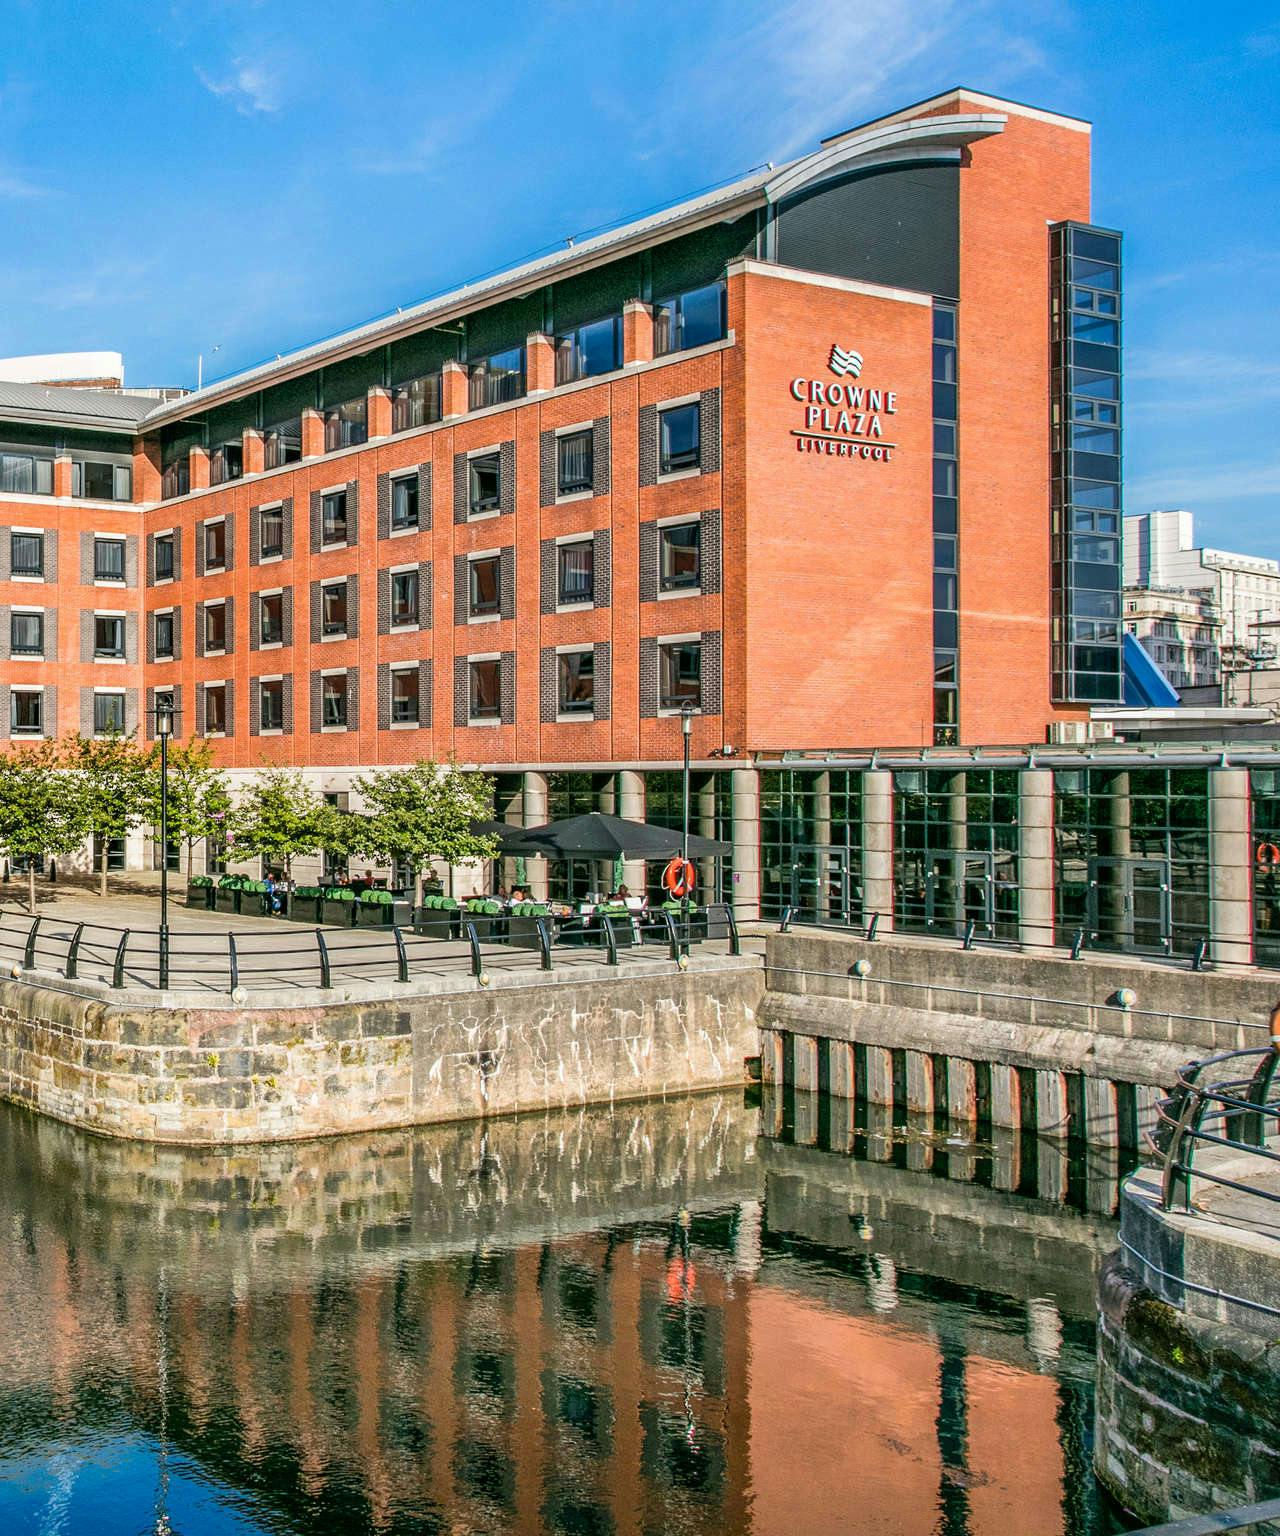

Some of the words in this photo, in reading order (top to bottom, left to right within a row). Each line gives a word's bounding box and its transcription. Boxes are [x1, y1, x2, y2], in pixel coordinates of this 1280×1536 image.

[791, 378, 897, 414] CROWNE
[806, 405, 882, 437] PLAZA
[797, 438, 892, 461] LIVERPOOL
